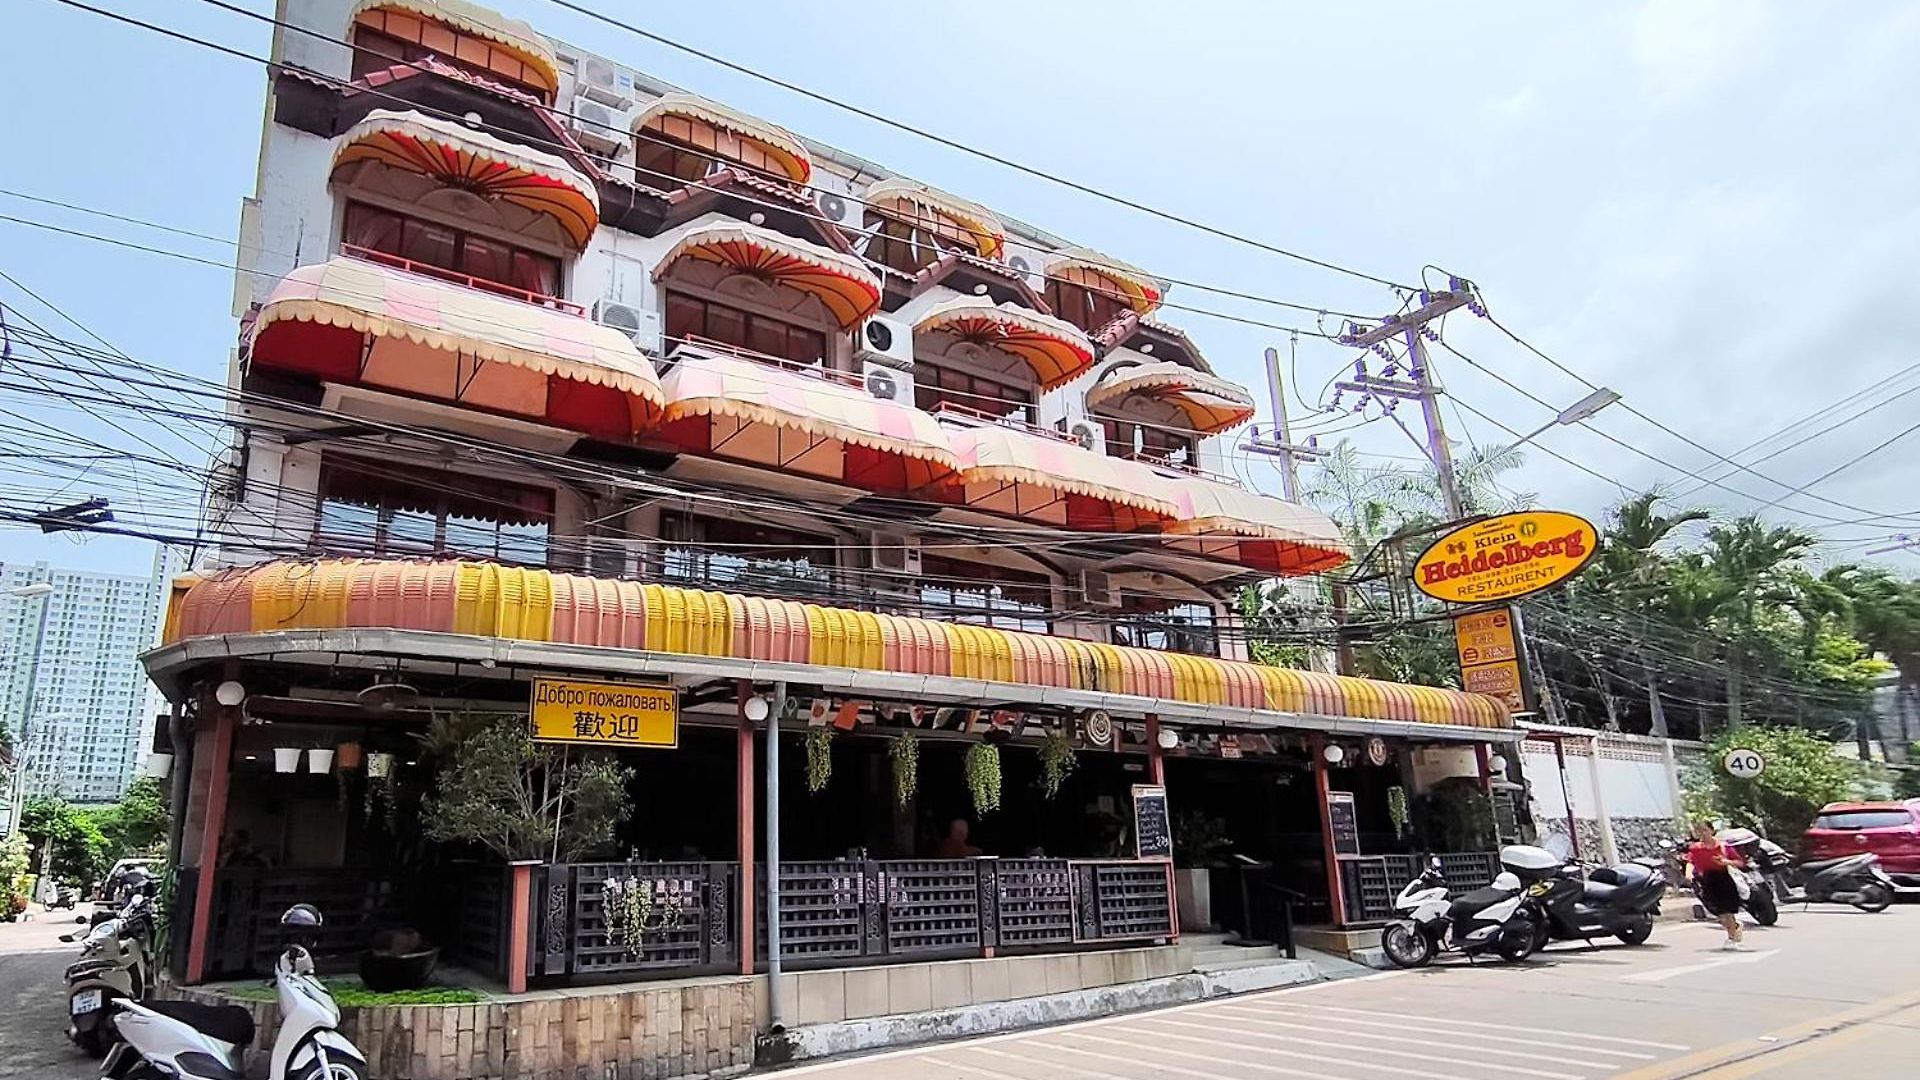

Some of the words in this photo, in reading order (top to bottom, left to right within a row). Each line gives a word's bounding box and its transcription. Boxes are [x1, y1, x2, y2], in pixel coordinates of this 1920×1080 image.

[1474, 532, 1516, 548] Klein
[1423, 530, 1586, 584] Heidelberg
[1457, 566, 1556, 596] RESTAURENT
[536, 683, 585, 709] Добро
[588, 689, 675, 712] пожаловать!
[573, 711, 640, 740] 歡迎
[1730, 756, 1759, 771] 40
